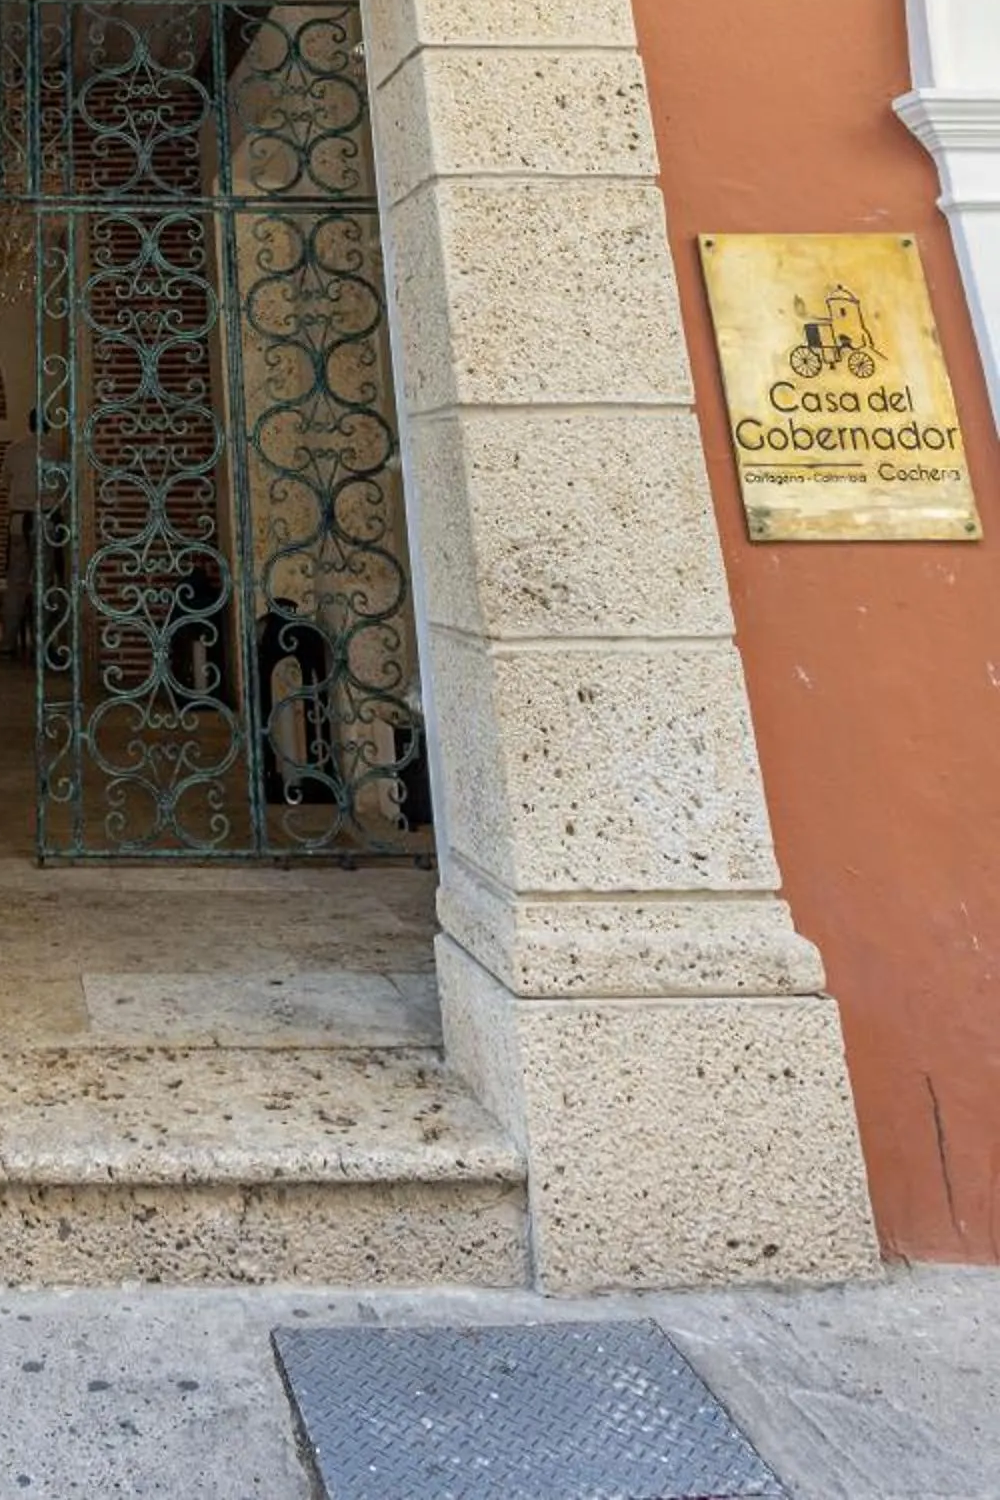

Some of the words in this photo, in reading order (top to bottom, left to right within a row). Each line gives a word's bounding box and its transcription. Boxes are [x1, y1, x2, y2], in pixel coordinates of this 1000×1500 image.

[769, 381, 861, 413] Casa
[867, 385, 914, 413] del
[735, 417, 959, 451] Gobernador
